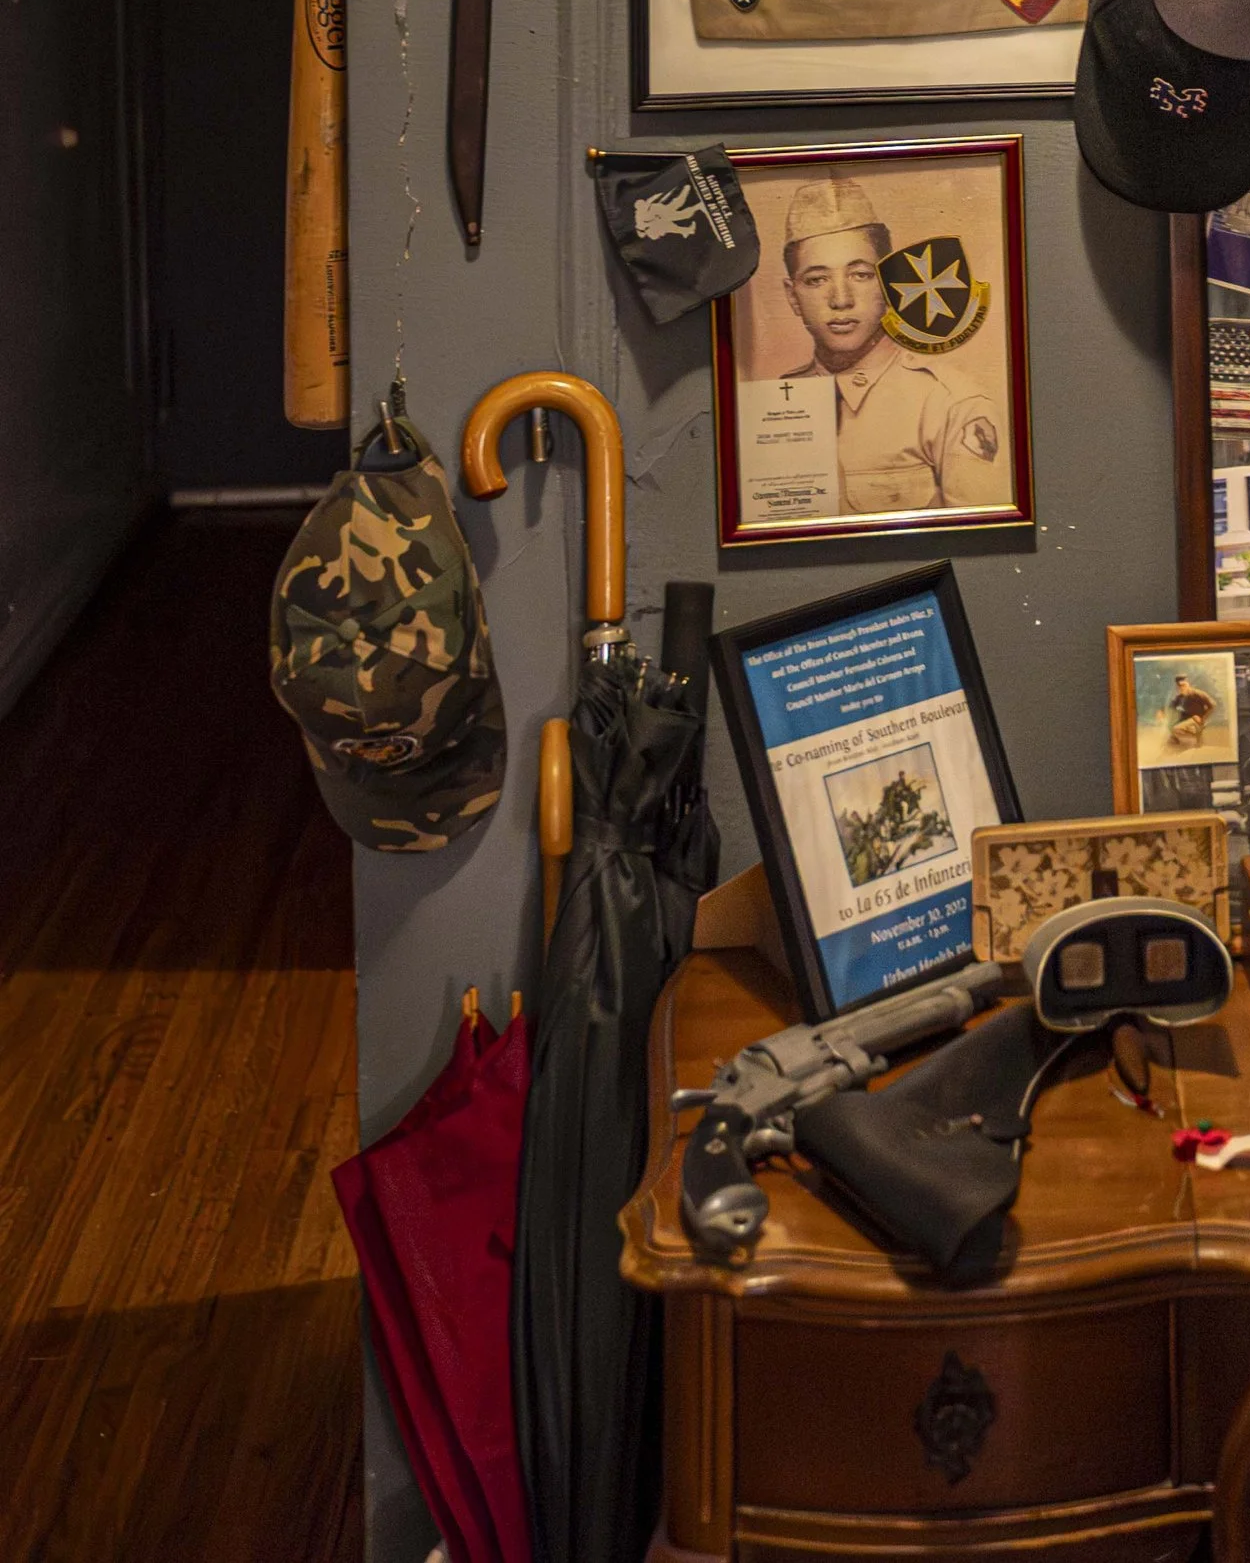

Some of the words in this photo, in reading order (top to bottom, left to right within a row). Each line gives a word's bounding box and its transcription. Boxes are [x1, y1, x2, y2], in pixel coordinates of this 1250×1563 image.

[786, 739, 850, 767] Co-naming
[852, 732, 864, 747] of
[866, 716, 918, 742] Southern
[920, 699, 969, 724] Boulevar
[839, 907, 853, 921] to
[856, 895, 871, 914] La
[875, 888, 892, 907] 65
[895, 880, 910, 900] de
[914, 856, 972, 892] Infanteri
[870, 914, 926, 944] November
